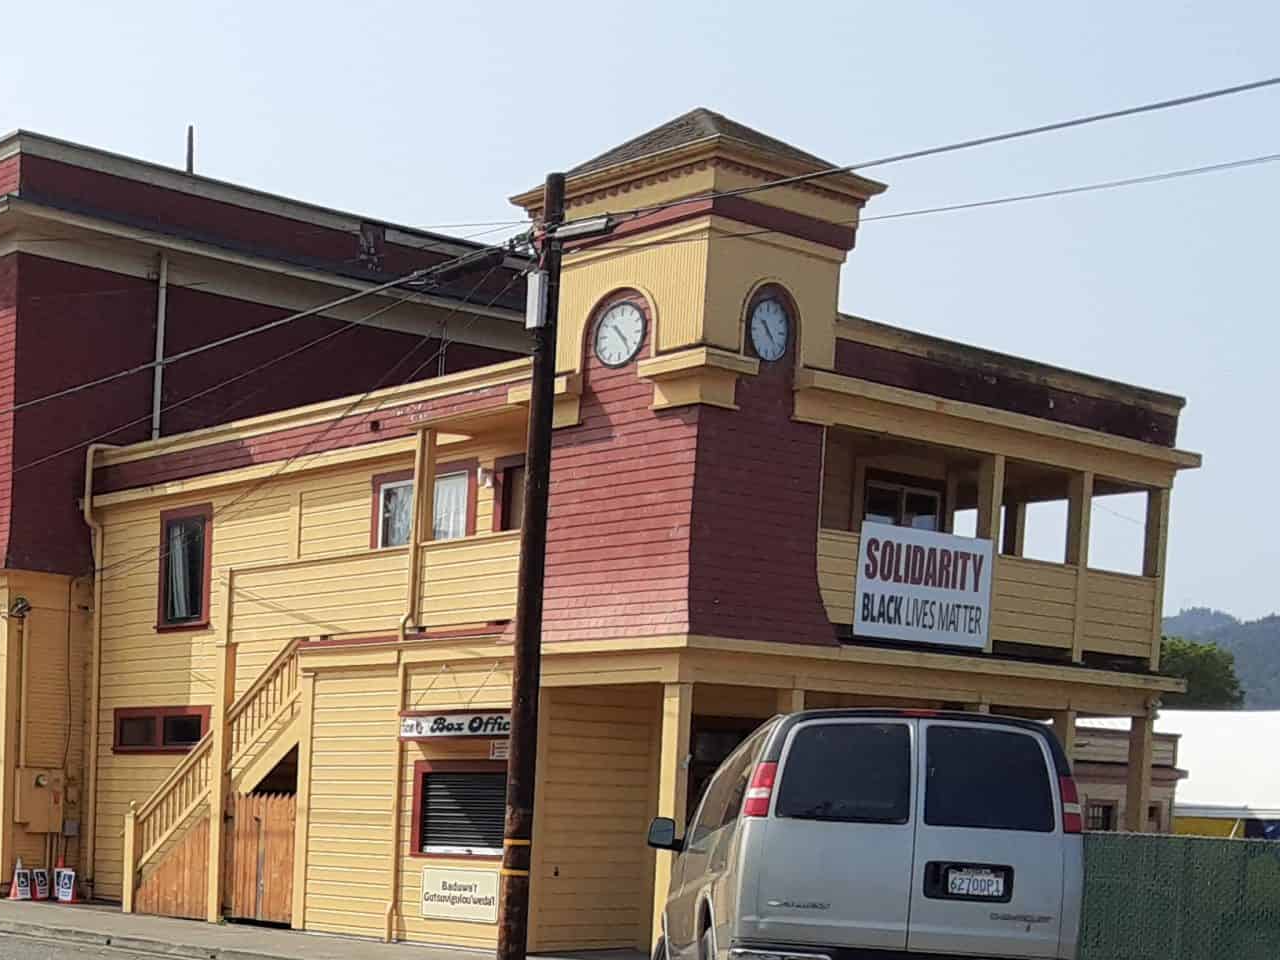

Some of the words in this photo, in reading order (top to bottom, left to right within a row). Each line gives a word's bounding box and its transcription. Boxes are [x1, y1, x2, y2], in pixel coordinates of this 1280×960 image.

[864, 538, 984, 592] SOLIDARITY
[861, 592, 903, 625] BLACK
[905, 597, 936, 630] LIVES
[937, 602, 982, 634] MATTER
[430, 717, 465, 733] Box
[468, 716, 510, 733] Offic
